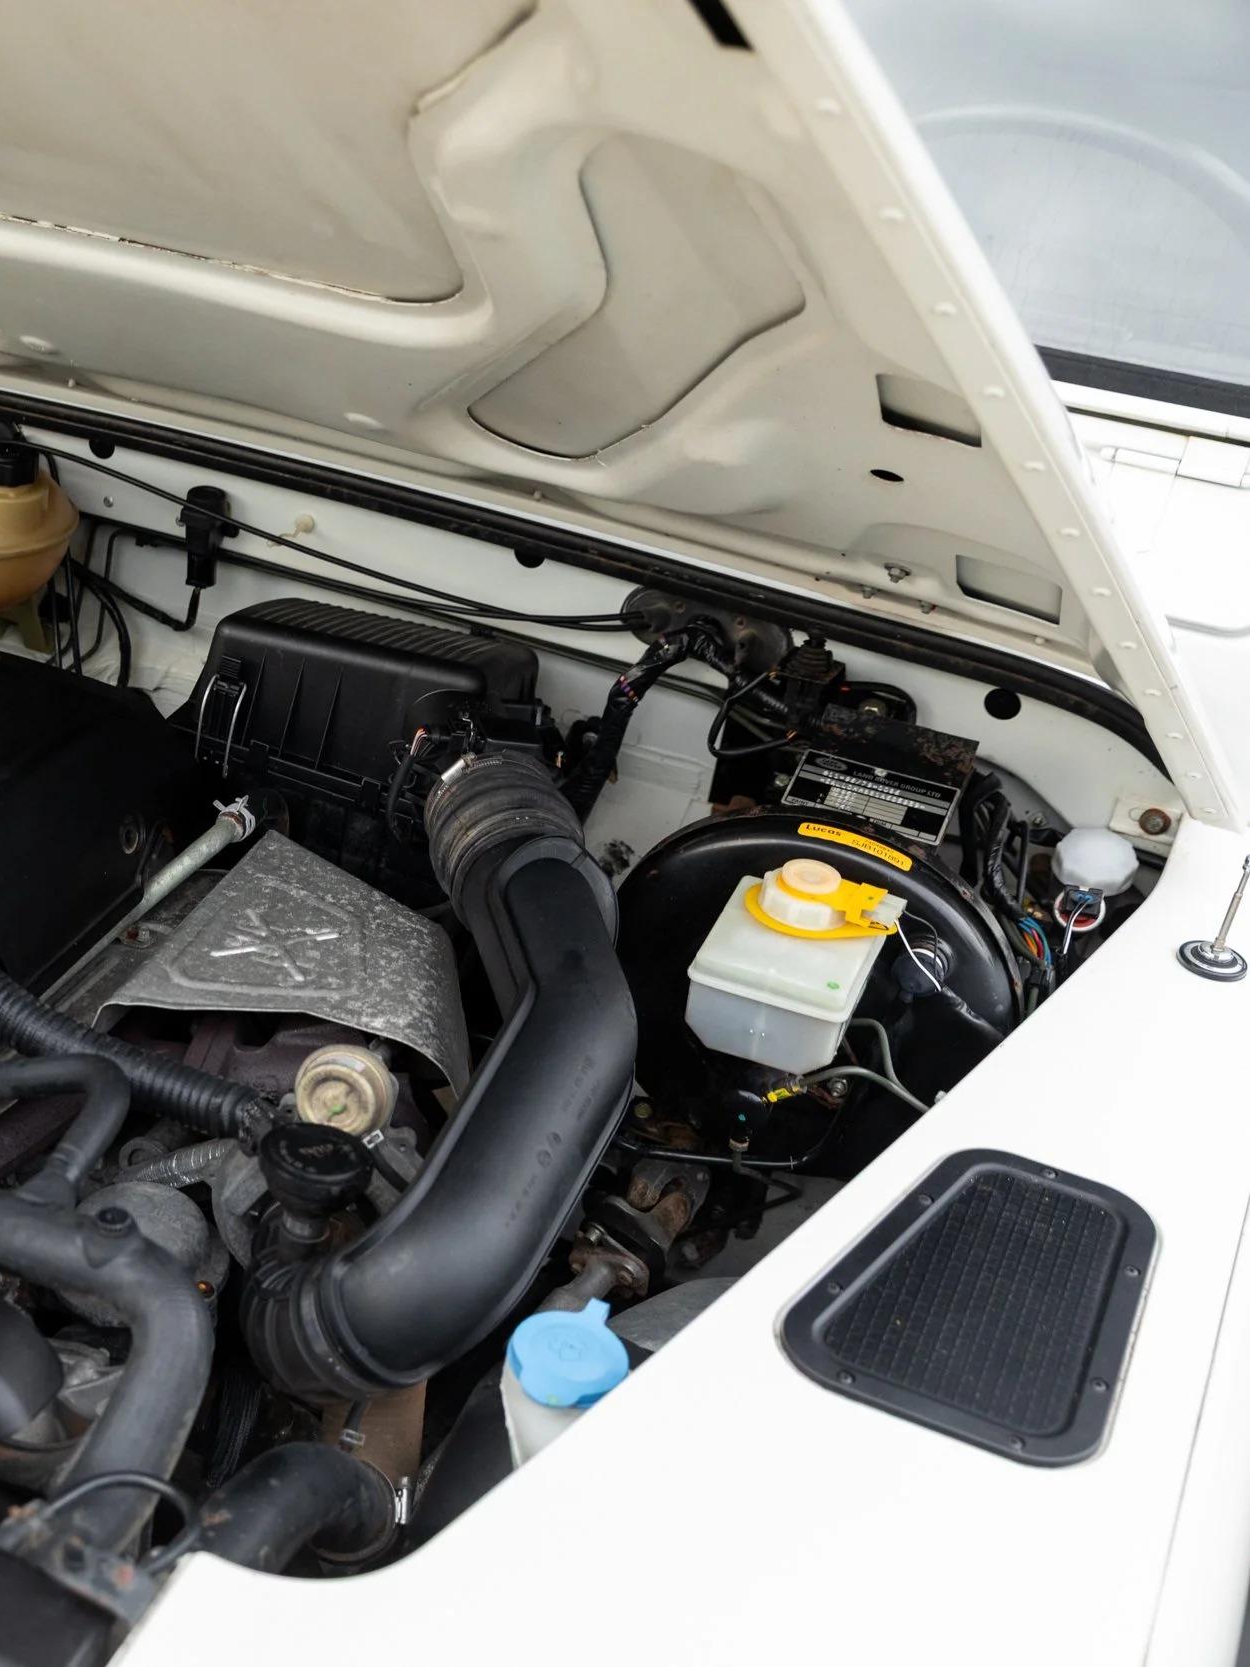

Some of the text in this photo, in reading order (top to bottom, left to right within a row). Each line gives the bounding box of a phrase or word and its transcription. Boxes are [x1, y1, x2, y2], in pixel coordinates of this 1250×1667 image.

[853, 770, 874, 781] LAND
[900, 782, 926, 794] GROUP
[805, 824, 842, 837] Lucas
